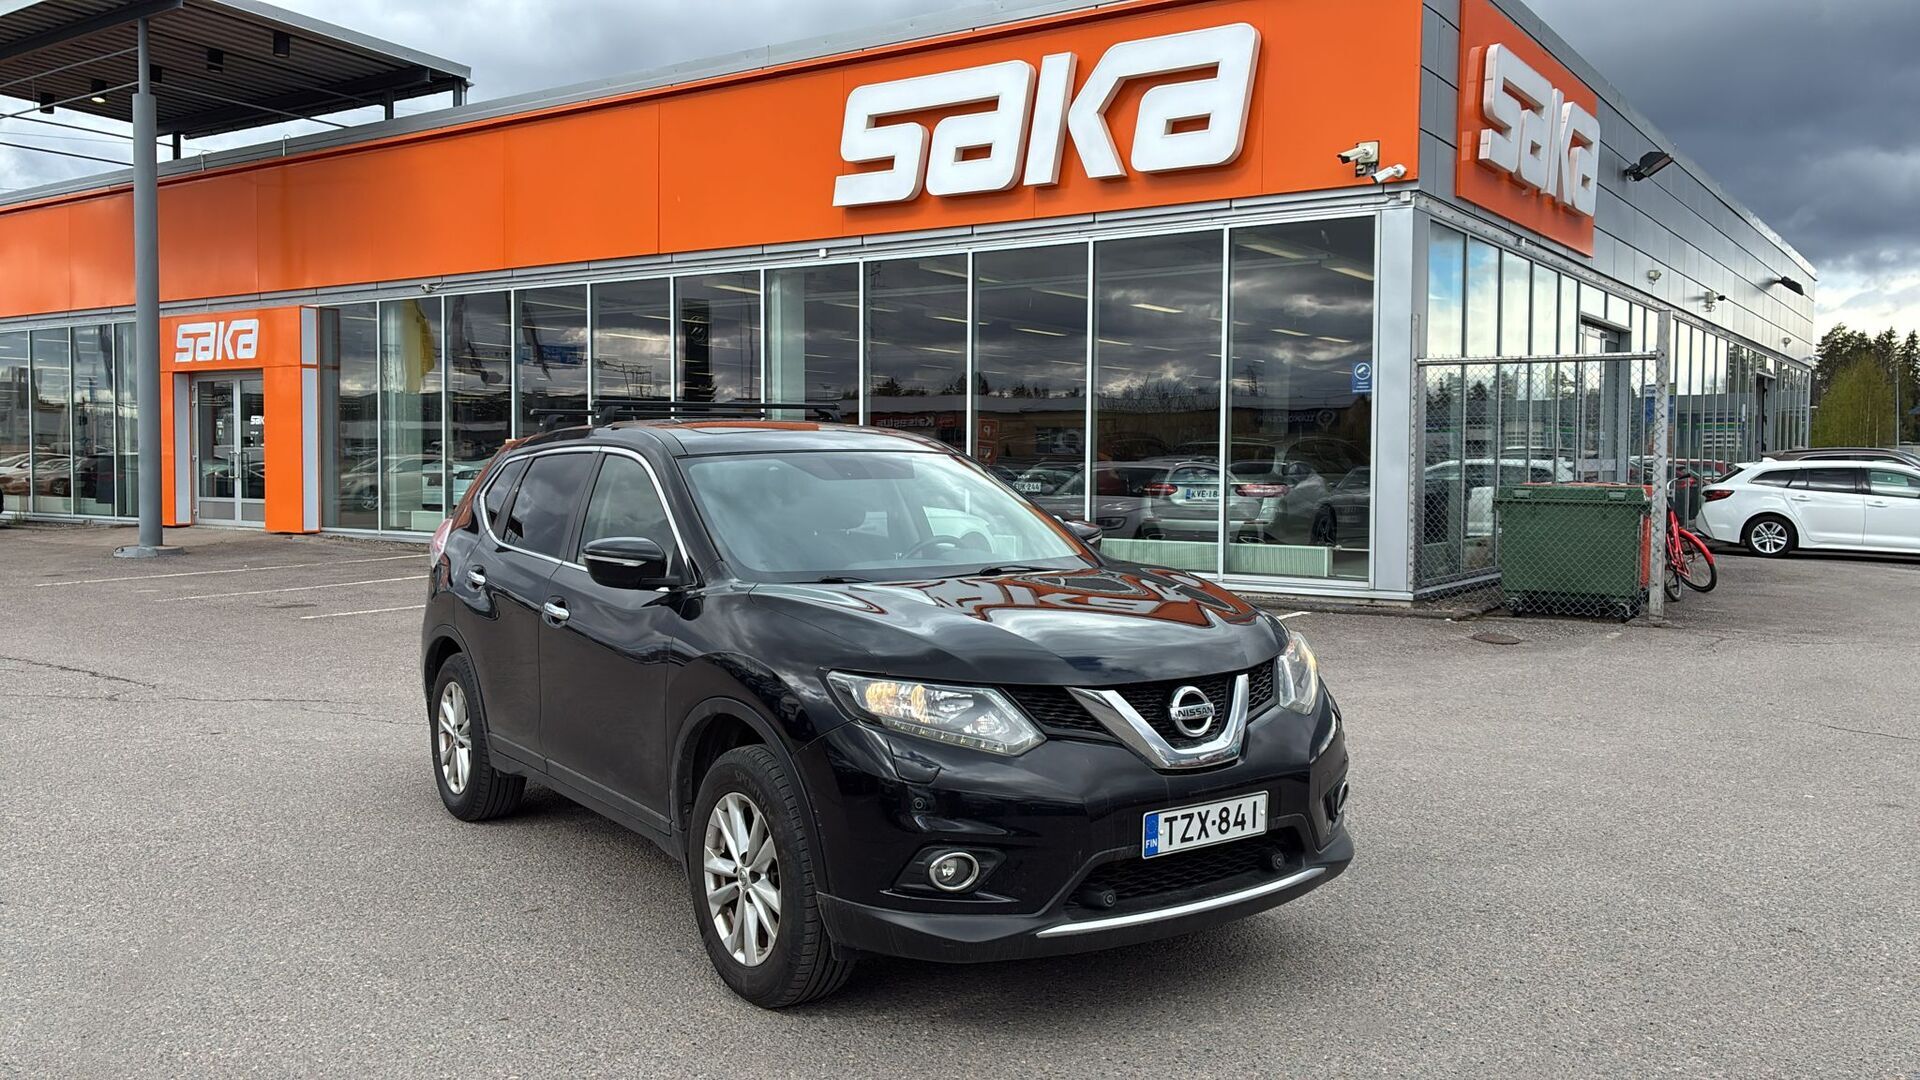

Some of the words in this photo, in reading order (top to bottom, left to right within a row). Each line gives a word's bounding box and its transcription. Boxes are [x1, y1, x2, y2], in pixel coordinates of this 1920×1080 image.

[1191, 489, 1220, 498] KVE-18
[1177, 706, 1212, 717] NISSAN
[1145, 837, 1158, 849] FIN
